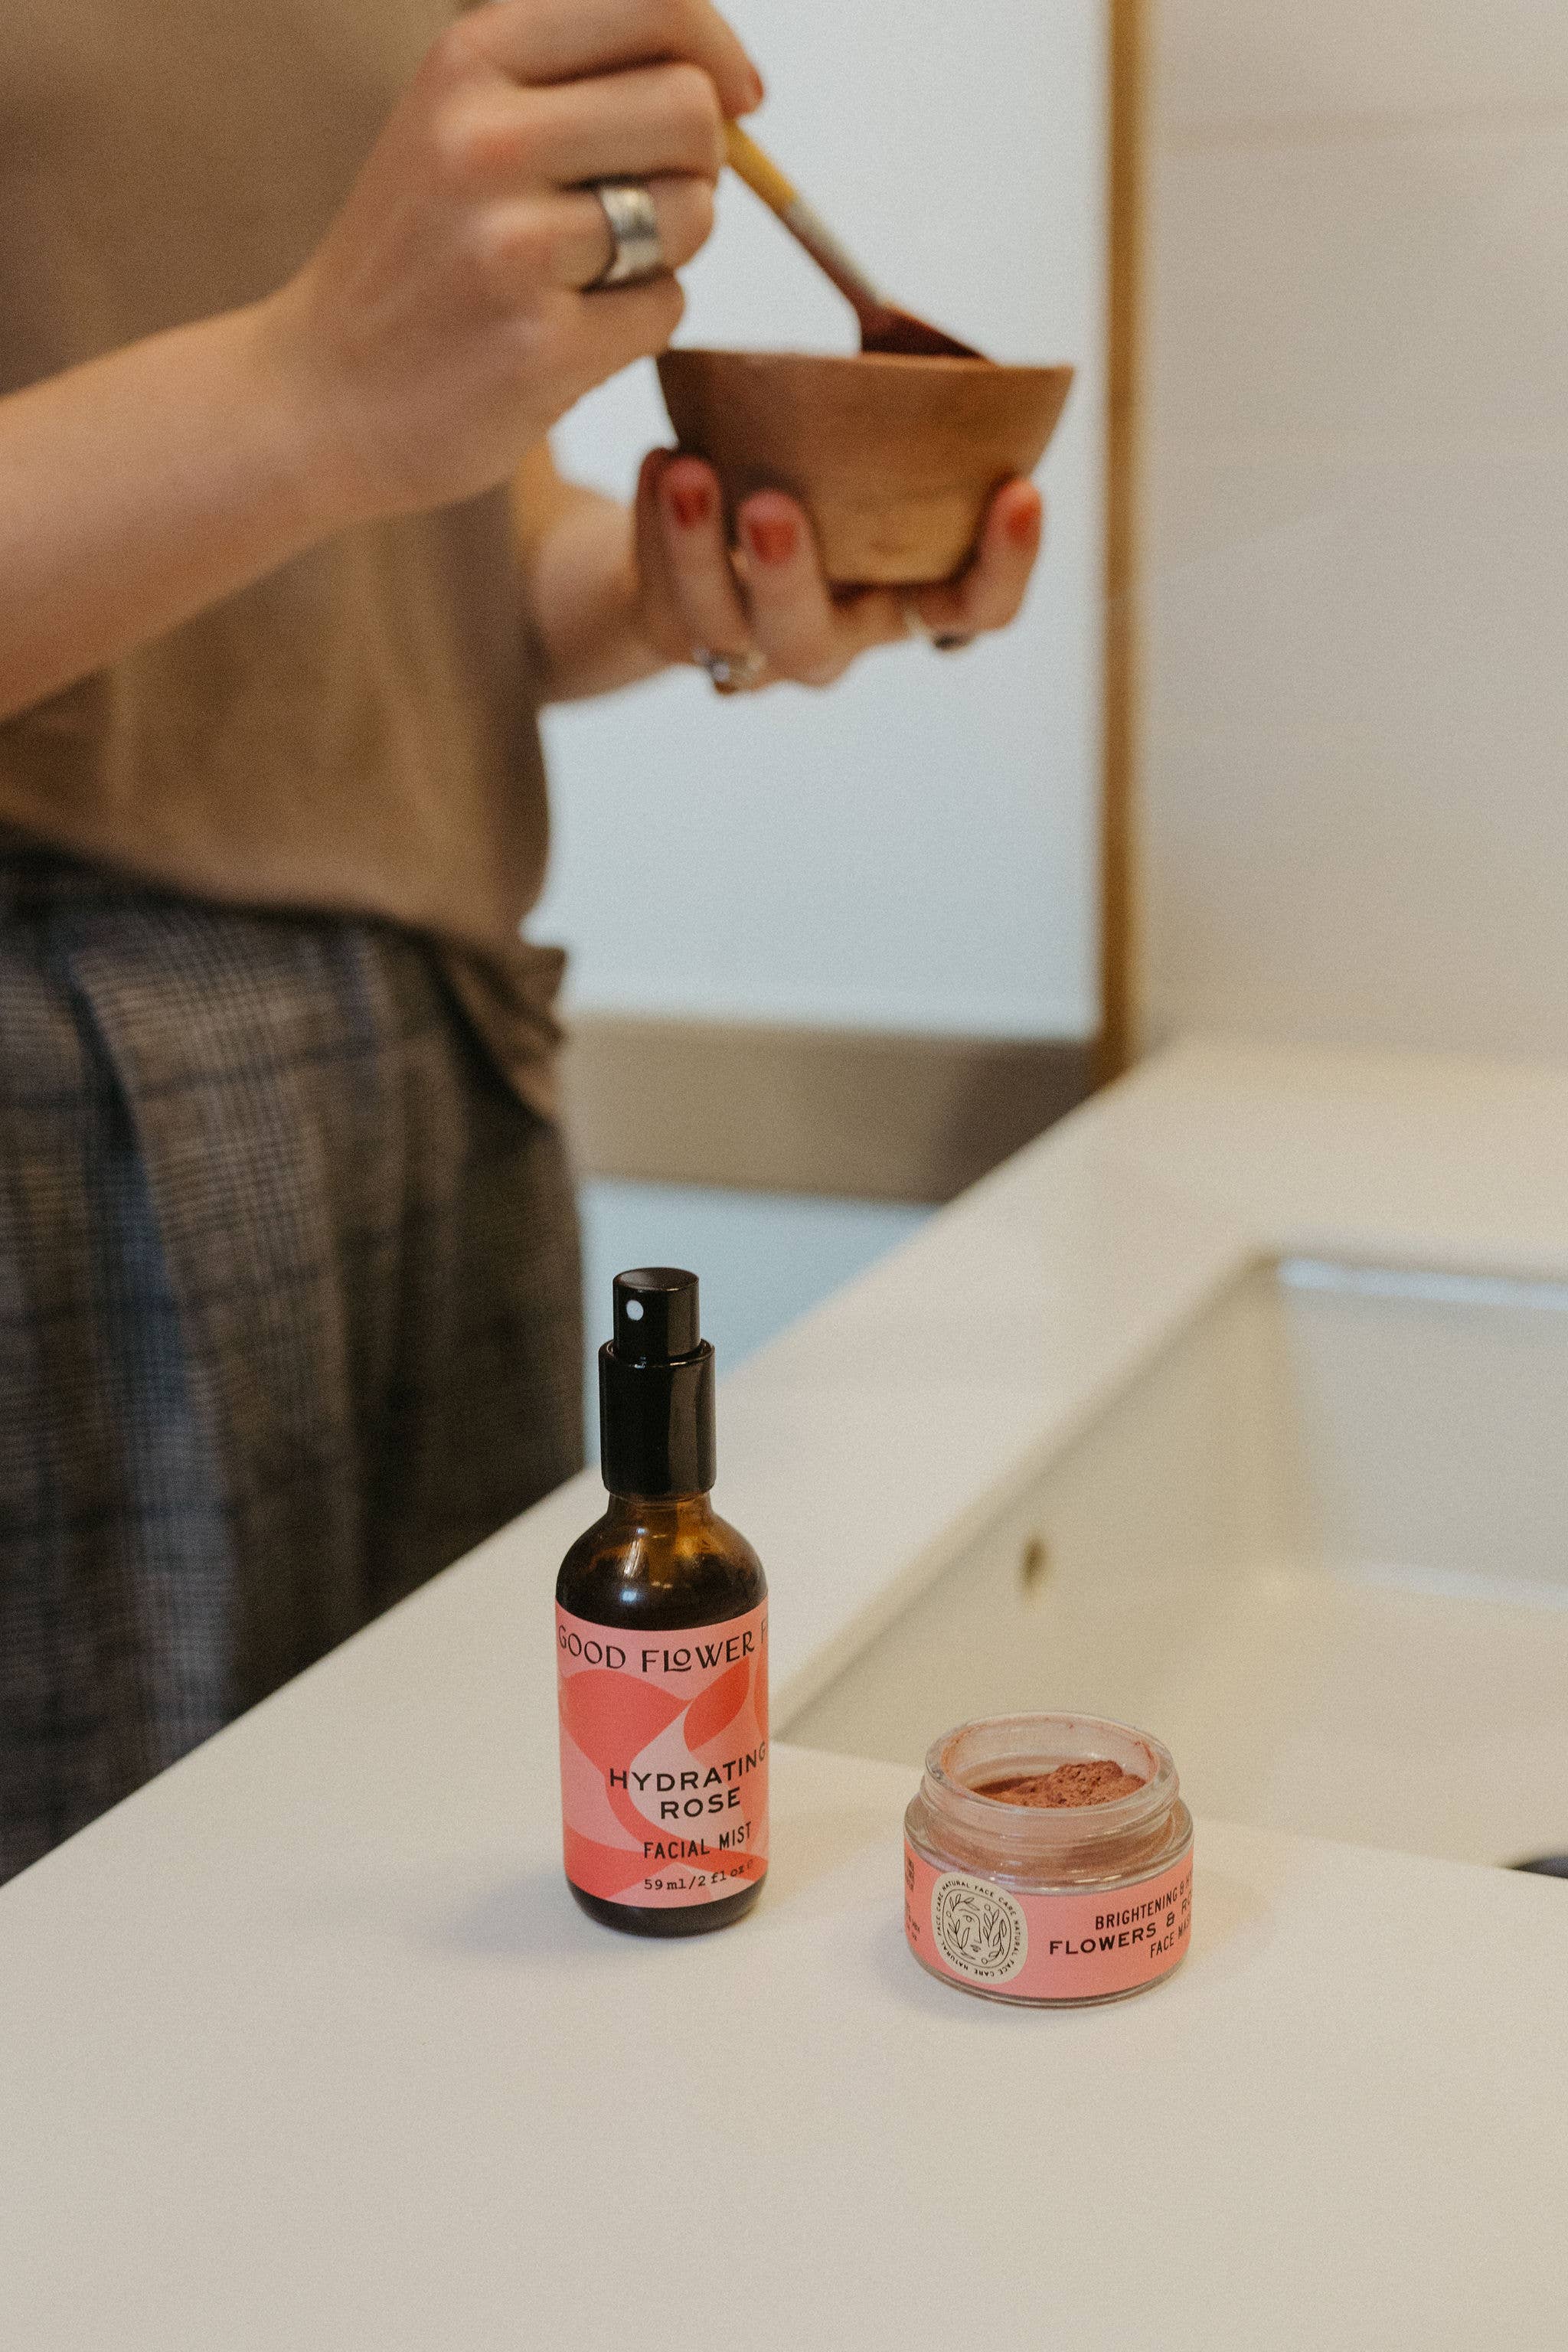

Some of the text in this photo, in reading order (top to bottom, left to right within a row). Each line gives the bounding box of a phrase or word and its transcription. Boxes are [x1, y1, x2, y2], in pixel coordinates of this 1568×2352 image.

[557, 1625, 626, 1669] GOOD
[641, 1630, 755, 1673] FLOWER
[609, 1741, 766, 1792] HYDRATING
[660, 1786, 740, 1820] ROSE
[643, 1821, 752, 1860] FACIAL MIST
[942, 1880, 969, 1892] NATURAL
[1095, 1886, 1178, 1931] BRIGHTENING
[1049, 1922, 1157, 1955] FLOWERS
[1150, 1931, 1175, 1958] FACE
